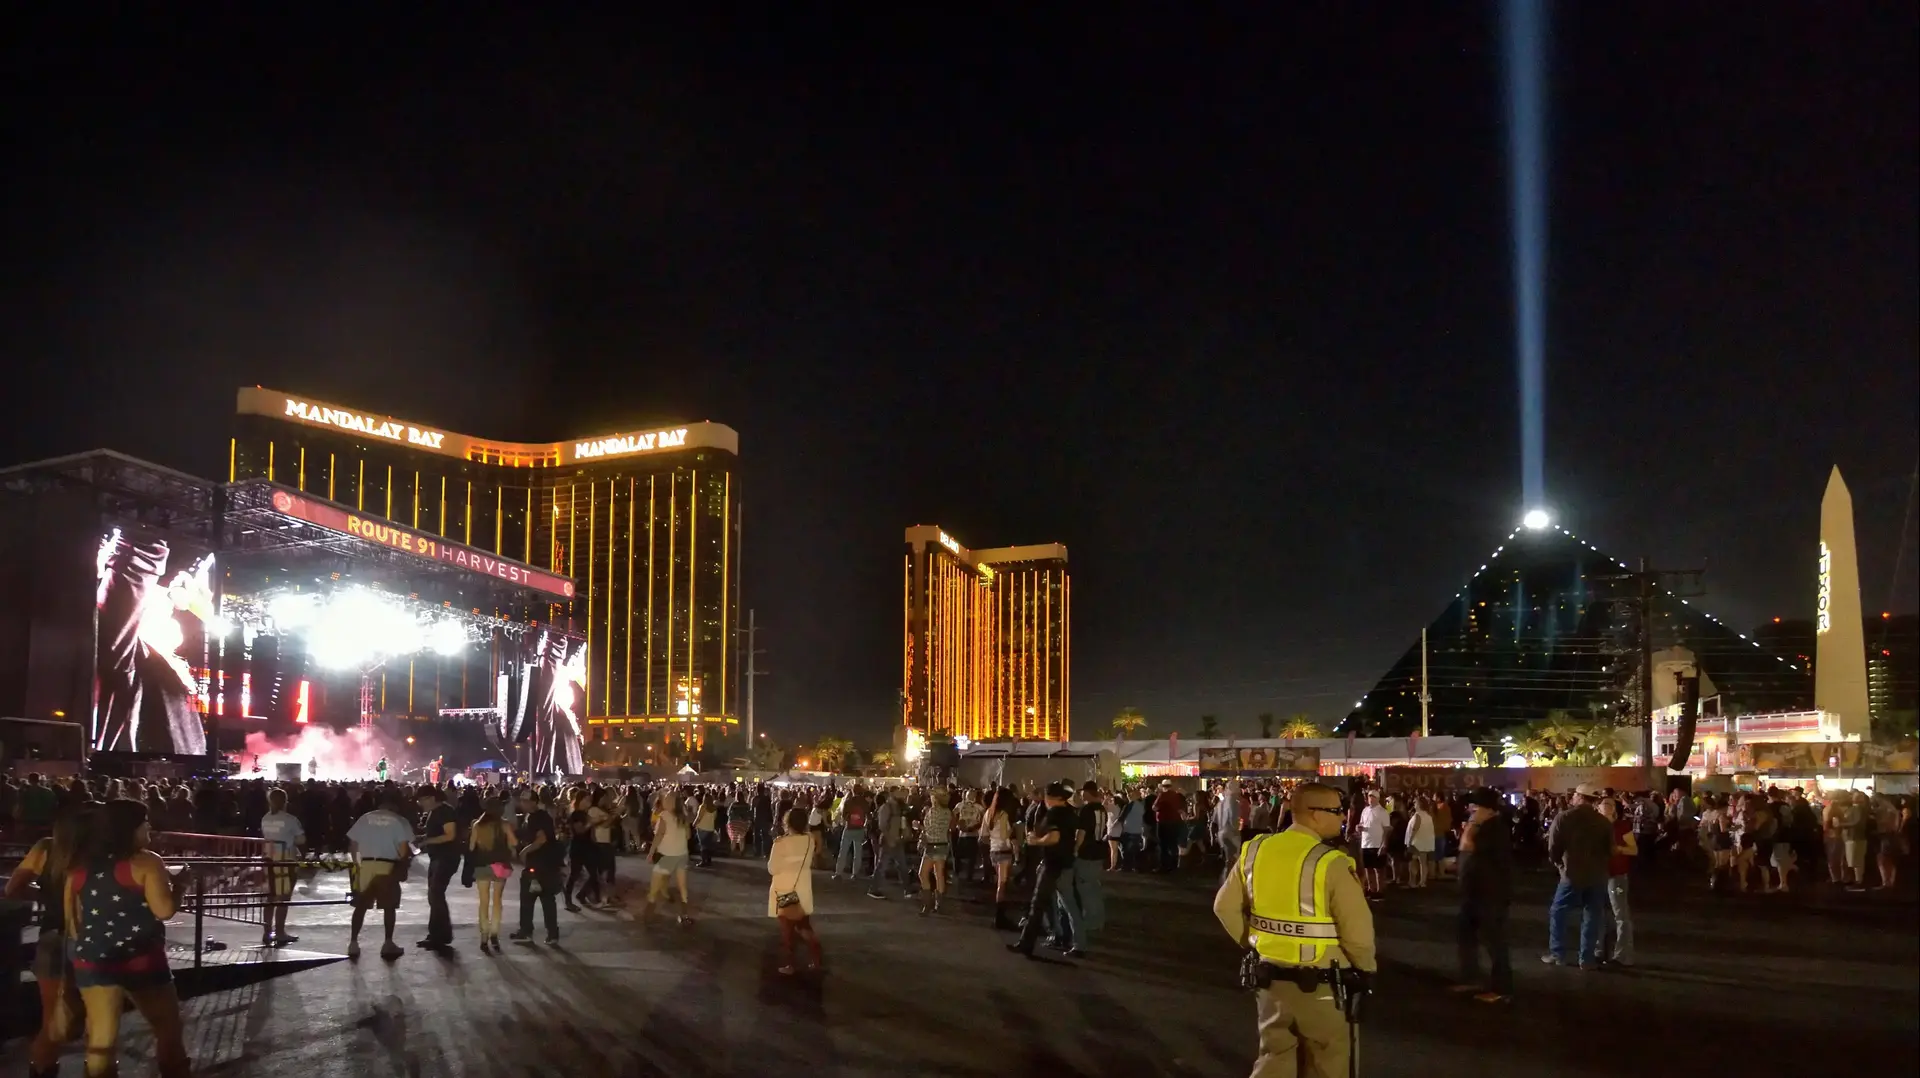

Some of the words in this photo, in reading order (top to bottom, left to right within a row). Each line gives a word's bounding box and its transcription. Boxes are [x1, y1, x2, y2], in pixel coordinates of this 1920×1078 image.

[285, 399, 404, 440] MANDALAY
[408, 426, 445, 448] BAY
[575, 433, 656, 459] MANDALAY
[658, 428, 688, 448] BAY
[347, 514, 412, 550] ROUTE
[417, 537, 436, 557] 91
[441, 545, 531, 584] HARVEST
[1817, 541, 1830, 634] LUXOR
[1253, 918, 1305, 935] POLICE
